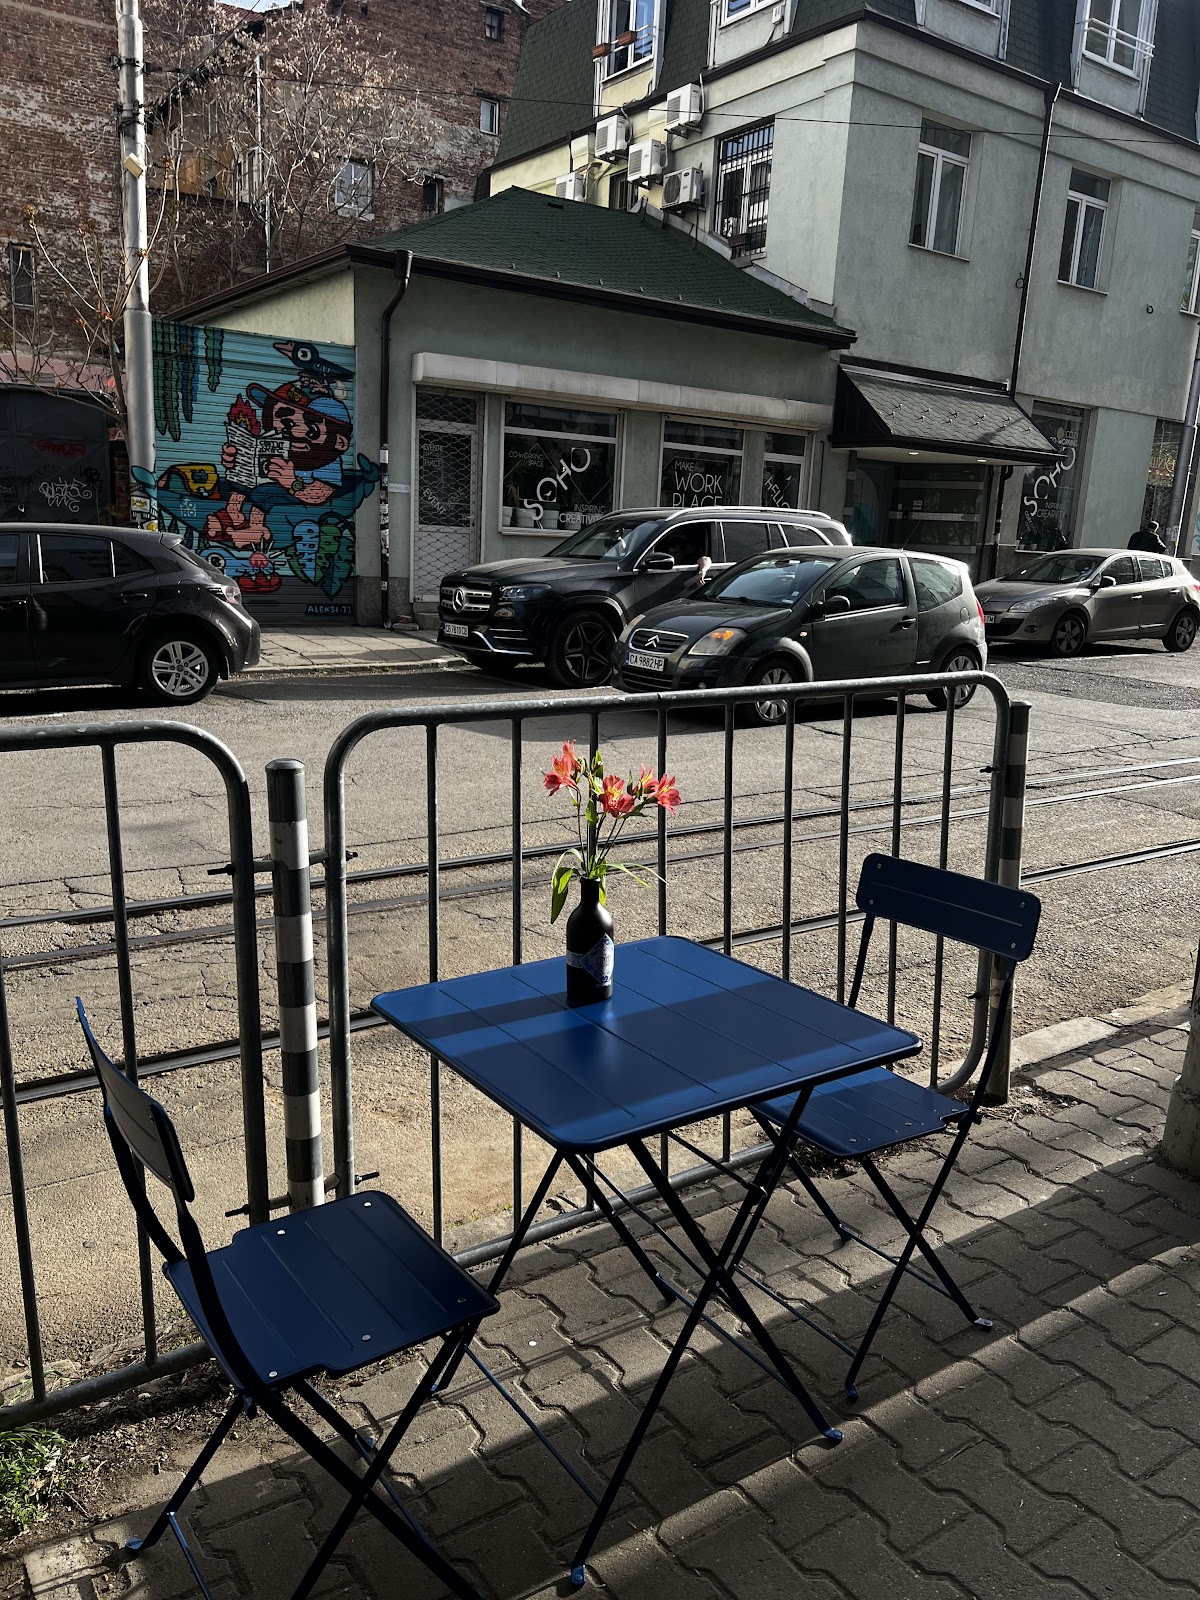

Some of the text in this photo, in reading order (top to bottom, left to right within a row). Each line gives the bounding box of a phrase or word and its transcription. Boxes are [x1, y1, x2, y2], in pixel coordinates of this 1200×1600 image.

[508, 450, 544, 461] CO-WORKING
[674, 461, 694, 472] MAKE
[523, 447, 591, 521] SOHO
[674, 473, 723, 495] WORK
[423, 488, 447, 515] EVENT
[307, 605, 339, 614] ALEKSI
